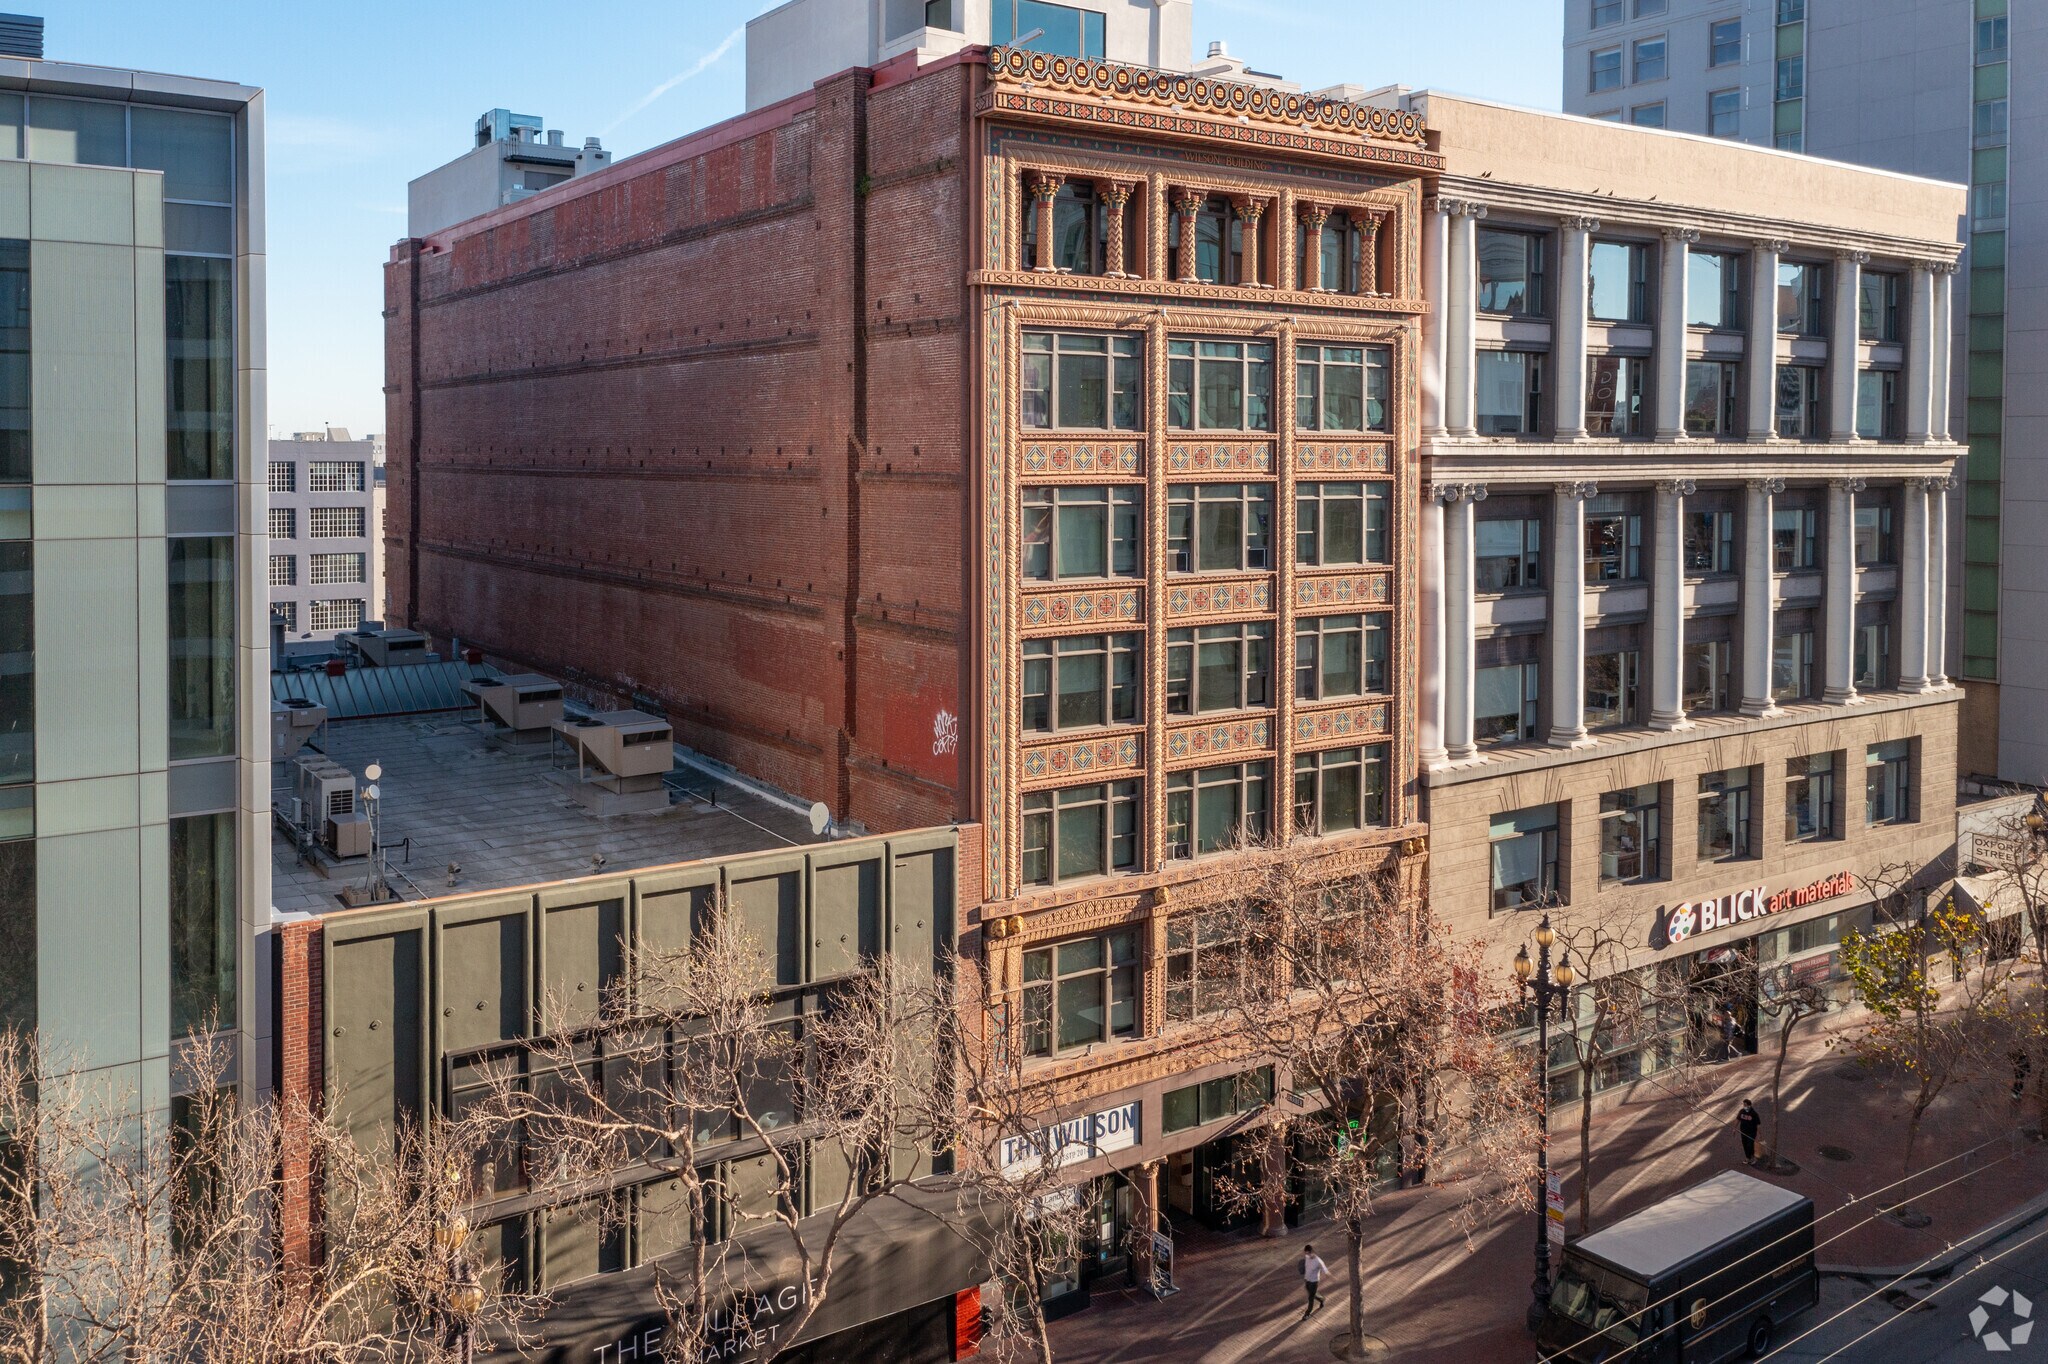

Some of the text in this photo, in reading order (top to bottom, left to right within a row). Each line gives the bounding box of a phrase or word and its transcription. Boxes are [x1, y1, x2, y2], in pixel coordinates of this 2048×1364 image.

[1184, 151, 1267, 170] WILSON BUILDING
[1701, 870, 1855, 932] BLICK art materials
[1053, 1105, 1135, 1149] WILSON
[1076, 1149, 1089, 1158] 201
[593, 1278, 818, 1364] THE ILAGE
